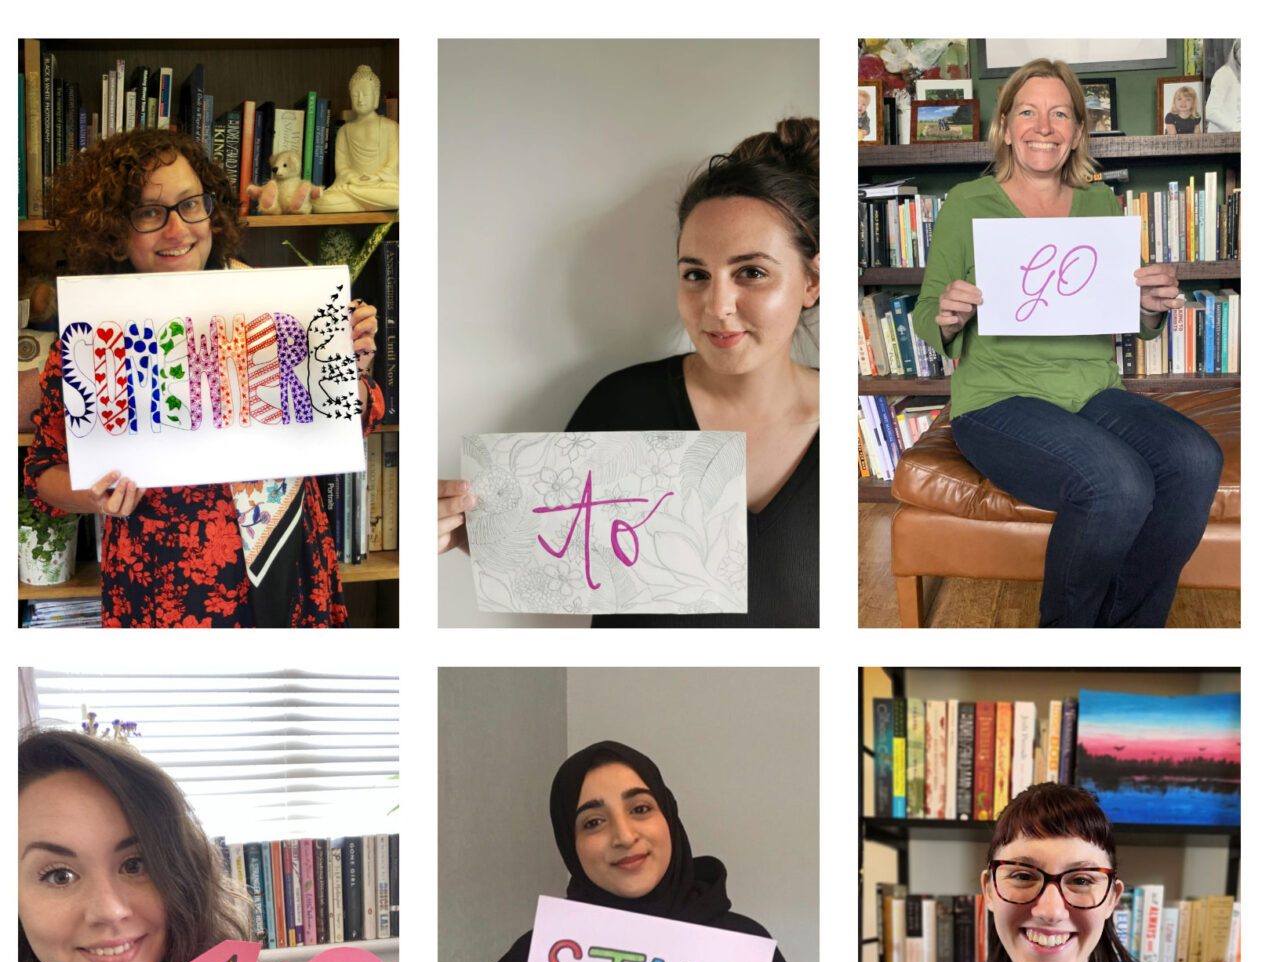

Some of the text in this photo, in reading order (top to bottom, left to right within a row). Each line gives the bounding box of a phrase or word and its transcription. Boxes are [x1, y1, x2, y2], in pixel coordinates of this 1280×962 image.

[386, 335, 397, 360] Until
[386, 365, 396, 387] Now
[326, 482, 335, 511] Portraits
[532, 470, 674, 589] to
[349, 868, 357, 887] GIRL
[1146, 905, 1160, 940] ALWAYS
